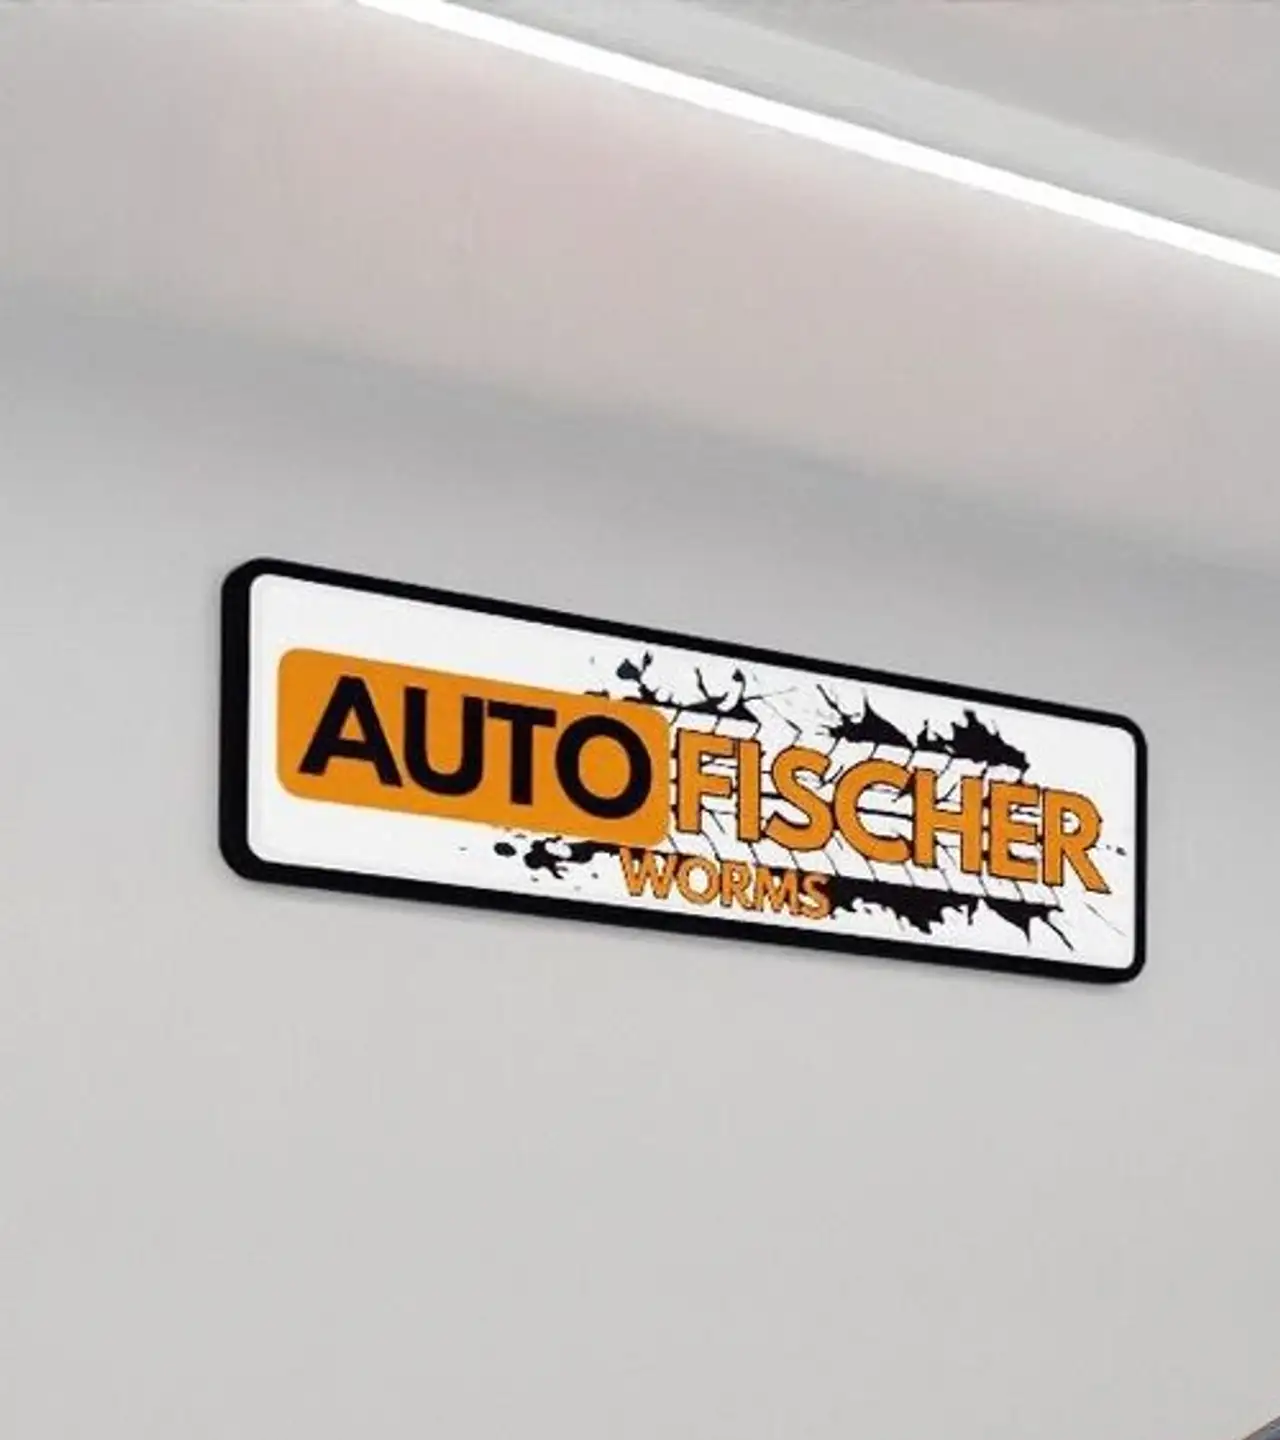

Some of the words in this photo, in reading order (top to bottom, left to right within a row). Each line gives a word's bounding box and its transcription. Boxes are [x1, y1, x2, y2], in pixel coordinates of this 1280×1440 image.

[298, 675, 653, 820] AUTO
[675, 728, 1111, 894] FISCHER
[621, 847, 832, 922] WORMS
